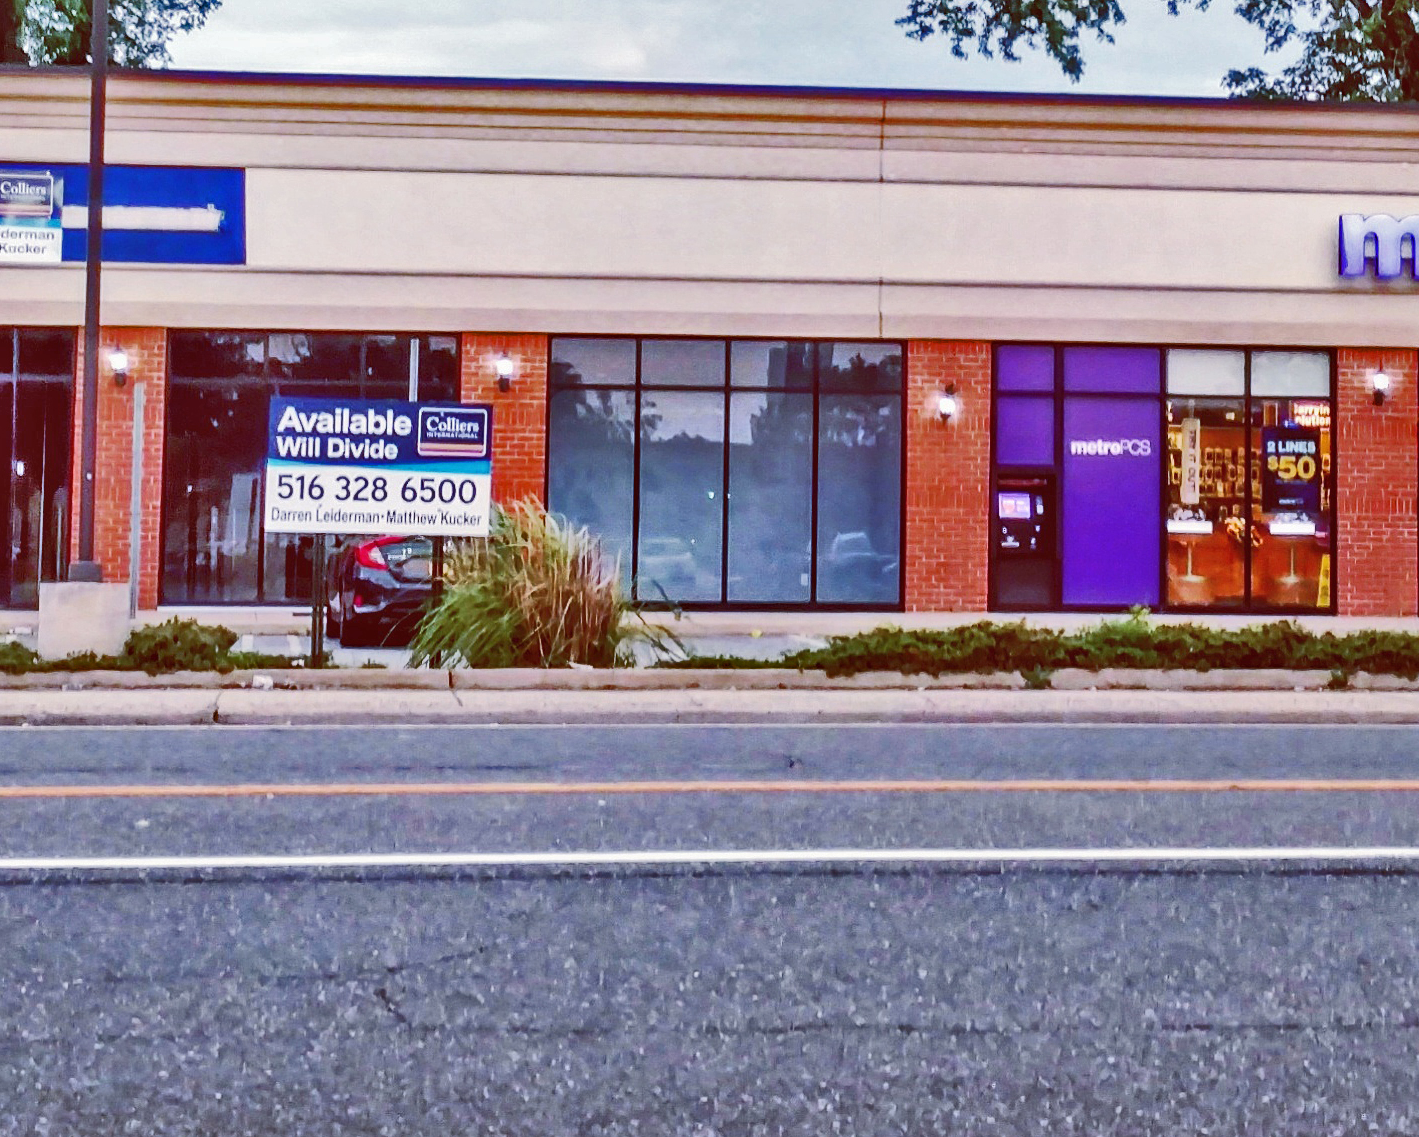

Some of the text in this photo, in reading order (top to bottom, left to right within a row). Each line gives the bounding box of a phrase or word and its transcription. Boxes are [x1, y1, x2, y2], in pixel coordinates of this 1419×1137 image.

[0, 180, 47, 196] Colliers
[277, 405, 412, 437] Available
[426, 416, 480, 433] Colliers
[276, 435, 399, 461] Will Divide
[1070, 438, 1152, 456] metroPCS
[1267, 440, 1317, 455] 2 LINES
[1267, 455, 1317, 480] $50
[277, 474, 477, 505] 516 328 6500
[271, 507, 312, 522] Darren
[386, 510, 439, 526] Matthew
[440, 512, 482, 527] Kucker
